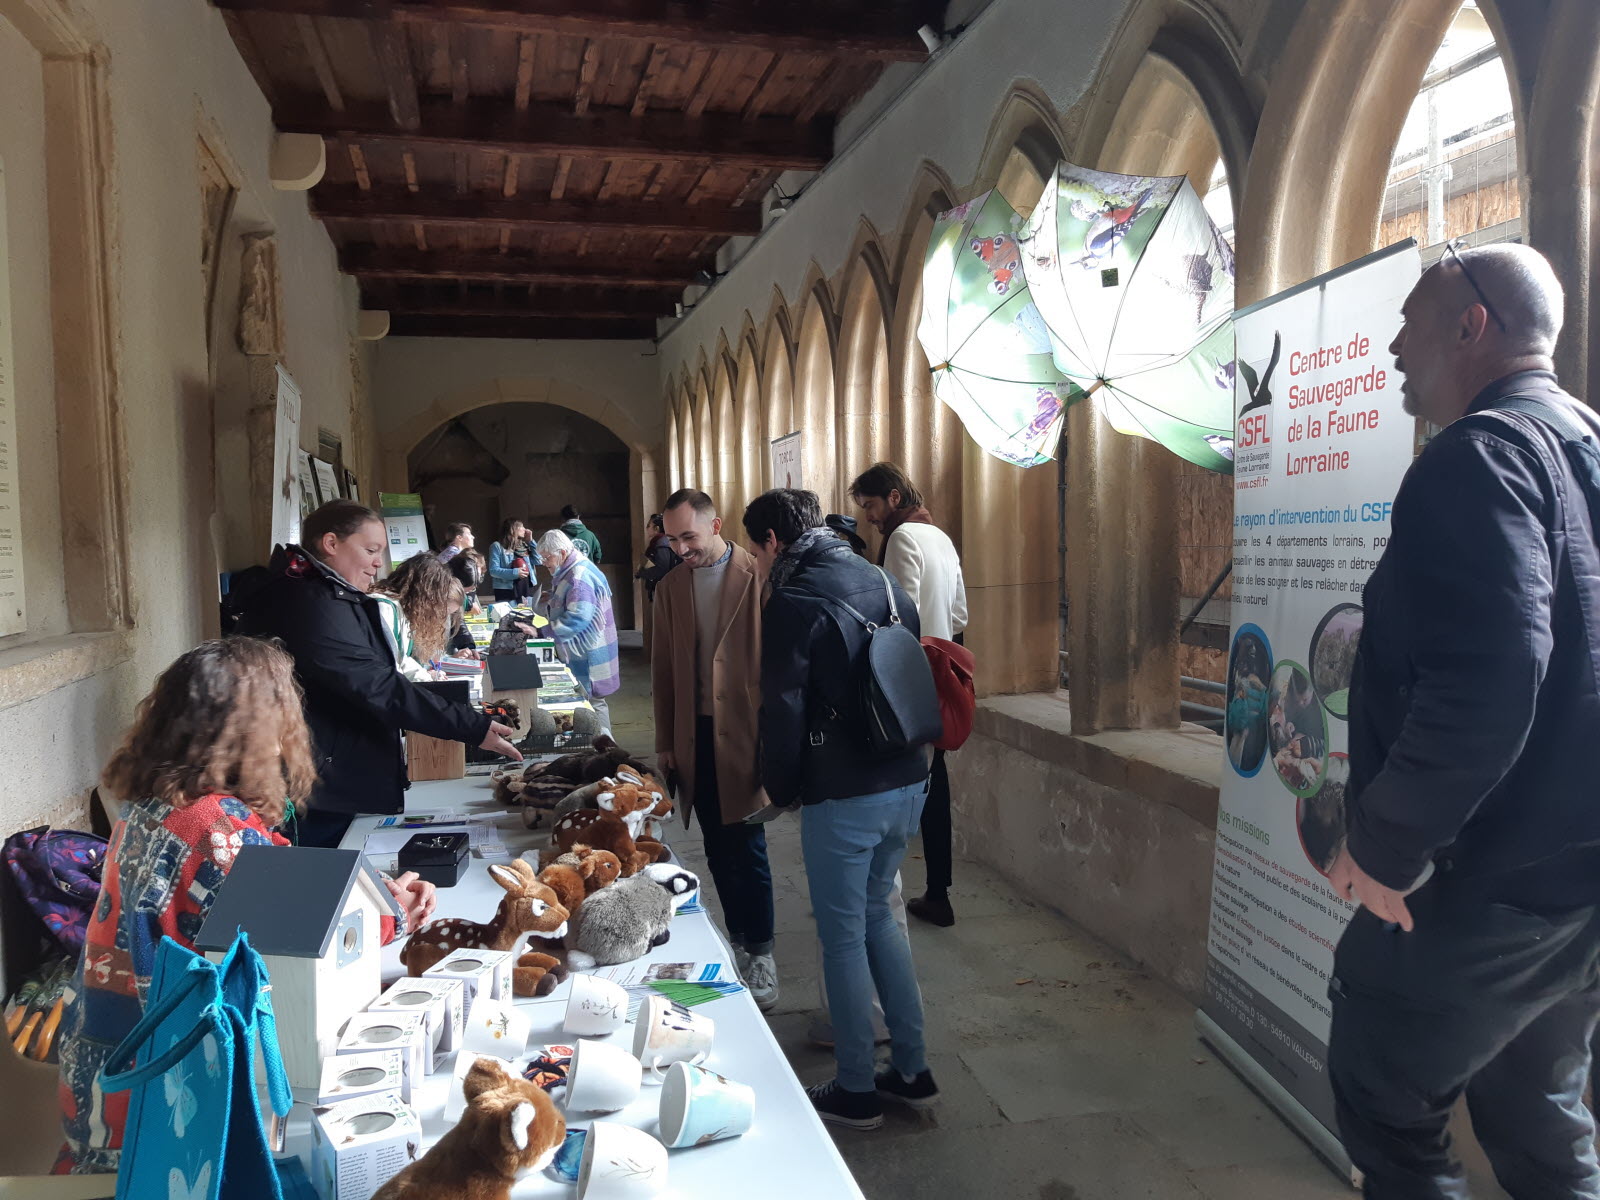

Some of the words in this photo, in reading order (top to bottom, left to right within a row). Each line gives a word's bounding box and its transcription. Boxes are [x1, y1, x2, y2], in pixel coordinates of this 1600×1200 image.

[1289, 344, 1342, 376] Centre
[1347, 332, 1370, 360] de
[1288, 364, 1386, 410] Sauvegarde
[1237, 413, 1271, 448] CSFL
[1287, 418, 1303, 443] de
[1306, 414, 1322, 439] la
[1327, 409, 1379, 436] Faune
[1249, 461, 1270, 472] Lorraine
[1250, 452, 1270, 463] Sauvegarde
[1286, 445, 1350, 476] Lorraine
[1240, 513, 1266, 531] rayon
[1268, 505, 1340, 526] d'intervention
[1343, 503, 1358, 523] du
[1361, 501, 1393, 522] CSF
[1250, 535, 1261, 547] les
[1265, 534, 1272, 547] 4
[1276, 535, 1328, 550] départements
[1332, 533, 1366, 549] lorrains,
[1372, 536, 1388, 551] po
[1254, 555, 1266, 567] les
[1268, 555, 1294, 567] animaux
[1295, 557, 1335, 572] sauvages
[1337, 559, 1347, 569] en
[1350, 556, 1381, 571] détres
[1245, 573, 1254, 585] de
[1254, 573, 1266, 586] les
[1267, 575, 1290, 590] soigner
[1290, 577, 1299, 588] et
[1300, 575, 1314, 589] les
[1315, 577, 1349, 592] relâcher
[1349, 579, 1366, 593] dan
[1243, 593, 1268, 606] naturel
[1232, 815, 1270, 846] missions
[1266, 873, 1282, 889] public
[1283, 883, 1289, 893] et
[1290, 885, 1301, 899] des
[1301, 893, 1327, 914] scolaires
[1328, 906, 1332, 917] à
[1333, 909, 1339, 921] la
[1340, 916, 1350, 926] pr
[1271, 860, 1279, 871] de
[1279, 865, 1311, 888] sauvegarde
[1312, 881, 1320, 893] de
[1320, 884, 1326, 896] la
[1326, 888, 1343, 906] faune
[1344, 900, 1357, 912] sau
[1278, 910, 1288, 923] des
[1289, 916, 1308, 935] études
[1281, 944, 1295, 960] dans
[1296, 952, 1301, 964] le
[1301, 957, 1318, 976] cadre
[1319, 969, 1327, 981] de
[1276, 970, 1303, 998] bénévoles
[1291, 1040, 1324, 1073] VALLEROY
